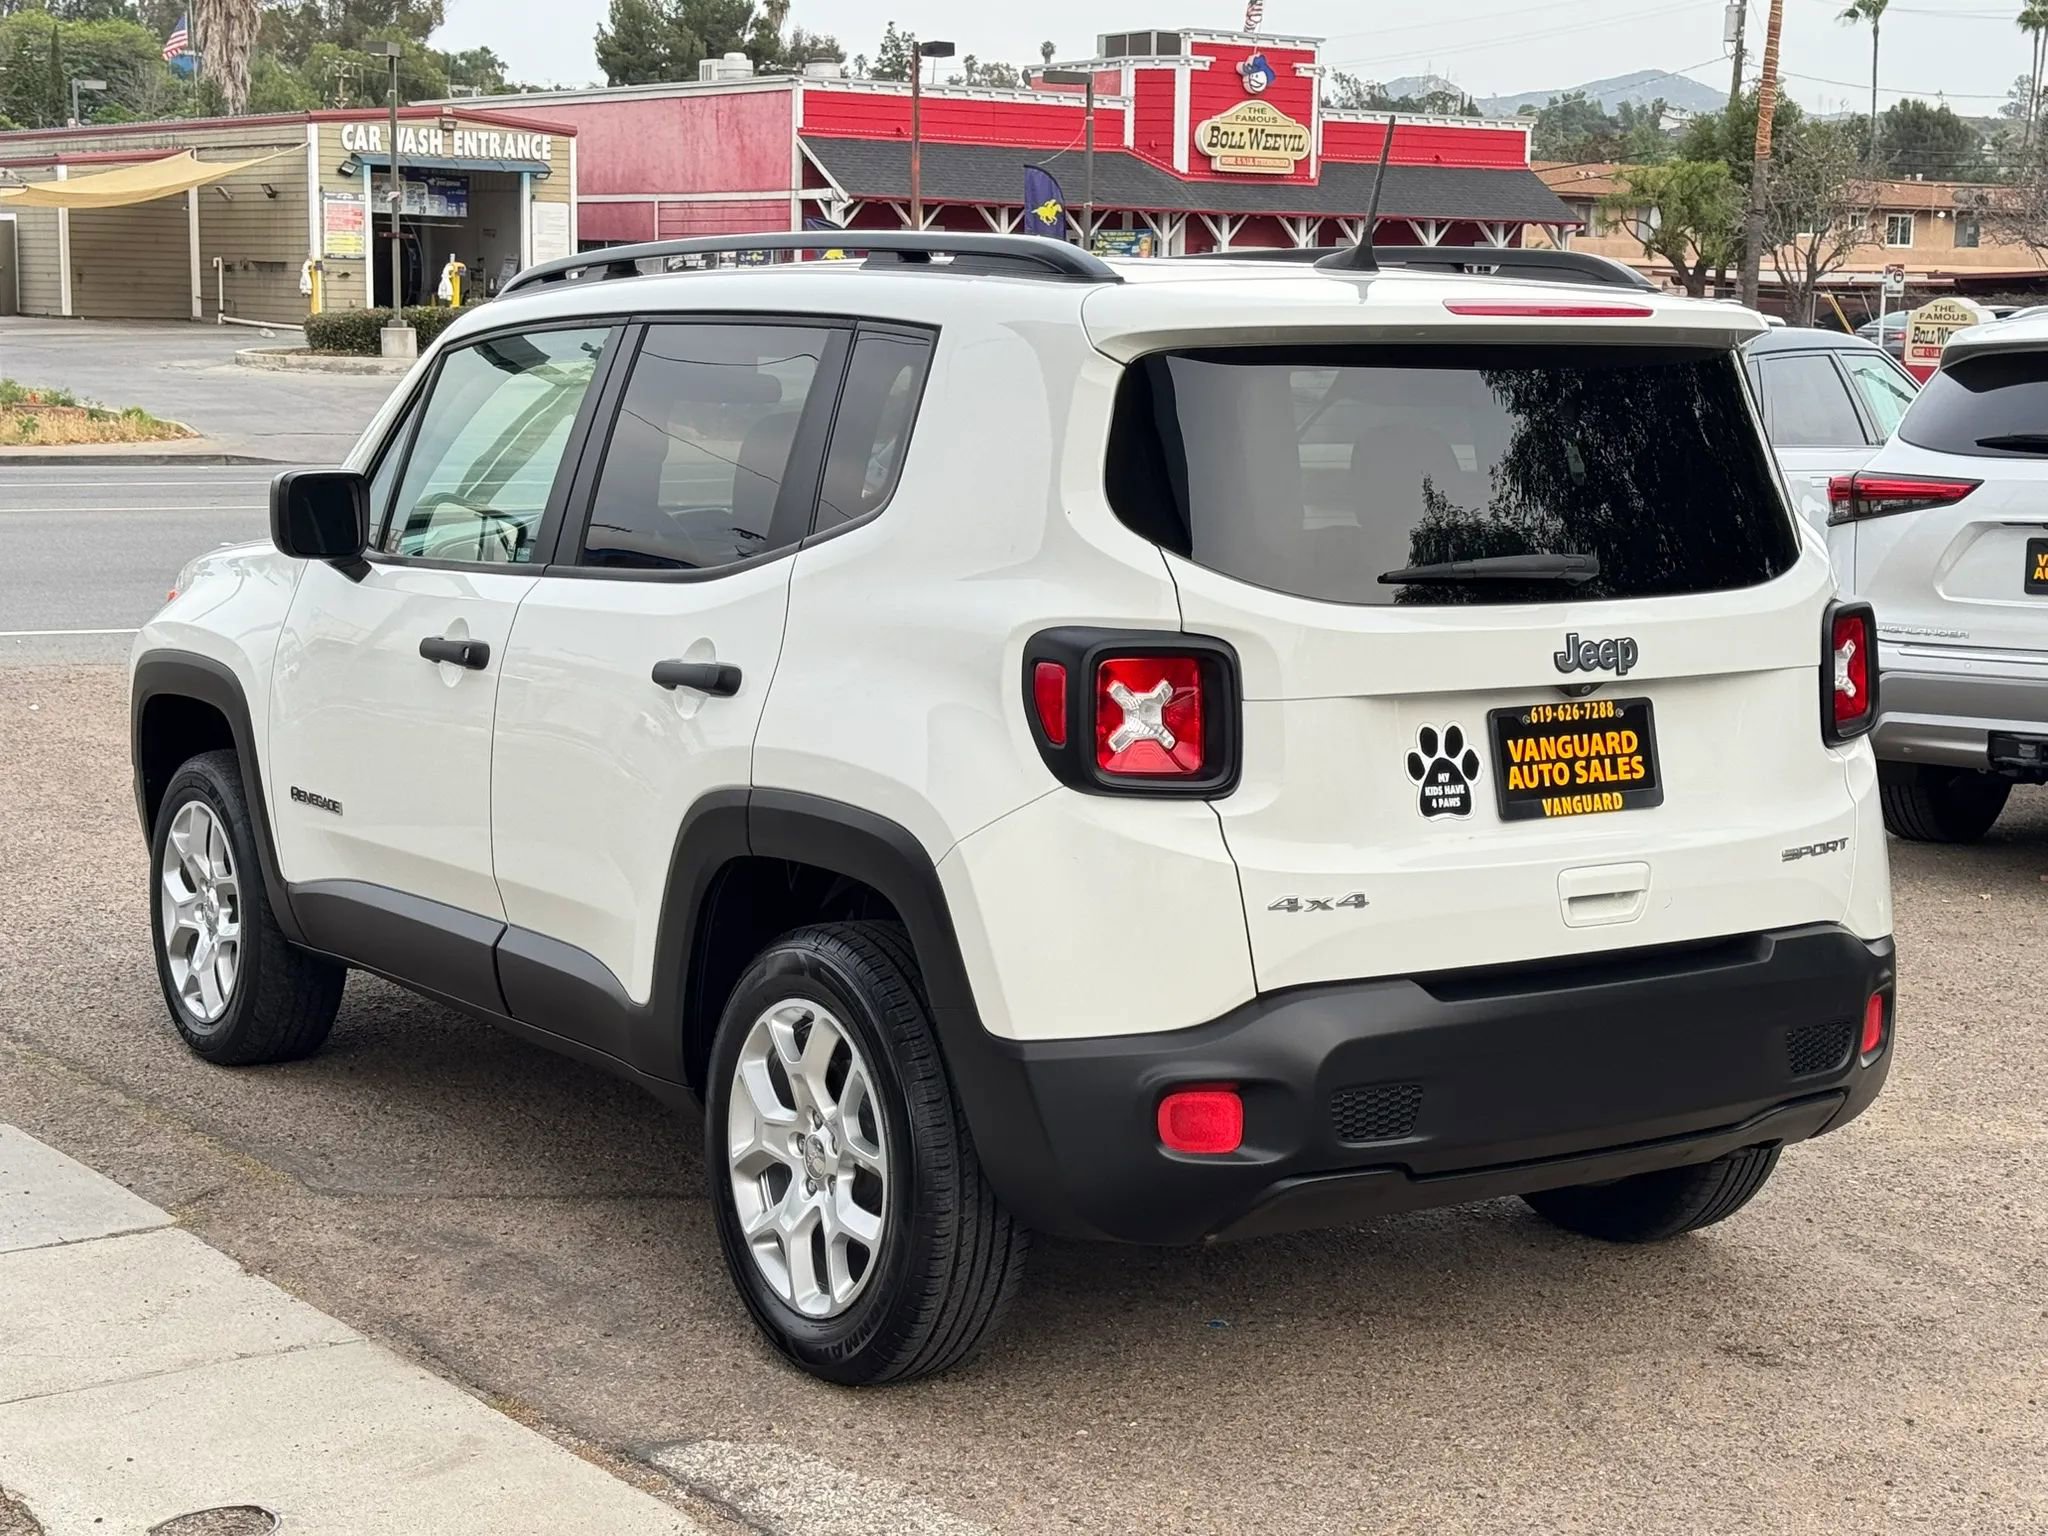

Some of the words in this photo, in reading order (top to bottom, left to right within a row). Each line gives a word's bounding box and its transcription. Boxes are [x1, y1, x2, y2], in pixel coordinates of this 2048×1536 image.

[1235, 114, 1278, 124] FAMOUS
[1247, 106, 1267, 115] THE
[341, 124, 382, 151] CAR
[387, 126, 443, 155] WASH
[453, 131, 552, 160] ENTRANCE
[1207, 125, 1247, 150] BOLL
[1248, 127, 1305, 152] WEEVIL
[1919, 312, 1968, 321] FAMOUS
[1933, 304, 1956, 313] THE
[1911, 326, 1936, 345] BOLL
[1877, 624, 1969, 640] HIGHLANDER
[1553, 633, 1639, 676] Jeep
[1507, 730, 1639, 763] VANGUARD
[1437, 772, 1450, 783] MY
[1508, 762, 1570, 790] AUTO
[1574, 755, 1646, 785] SALES
[290, 785, 341, 814] RENEGADE
[1424, 785, 1443, 797] KIDS
[1444, 784, 1466, 795] HAVE
[1438, 797, 1461, 808] PAWS
[1542, 792, 1623, 817] VANGUARD
[1781, 837, 1849, 863] SPORT
